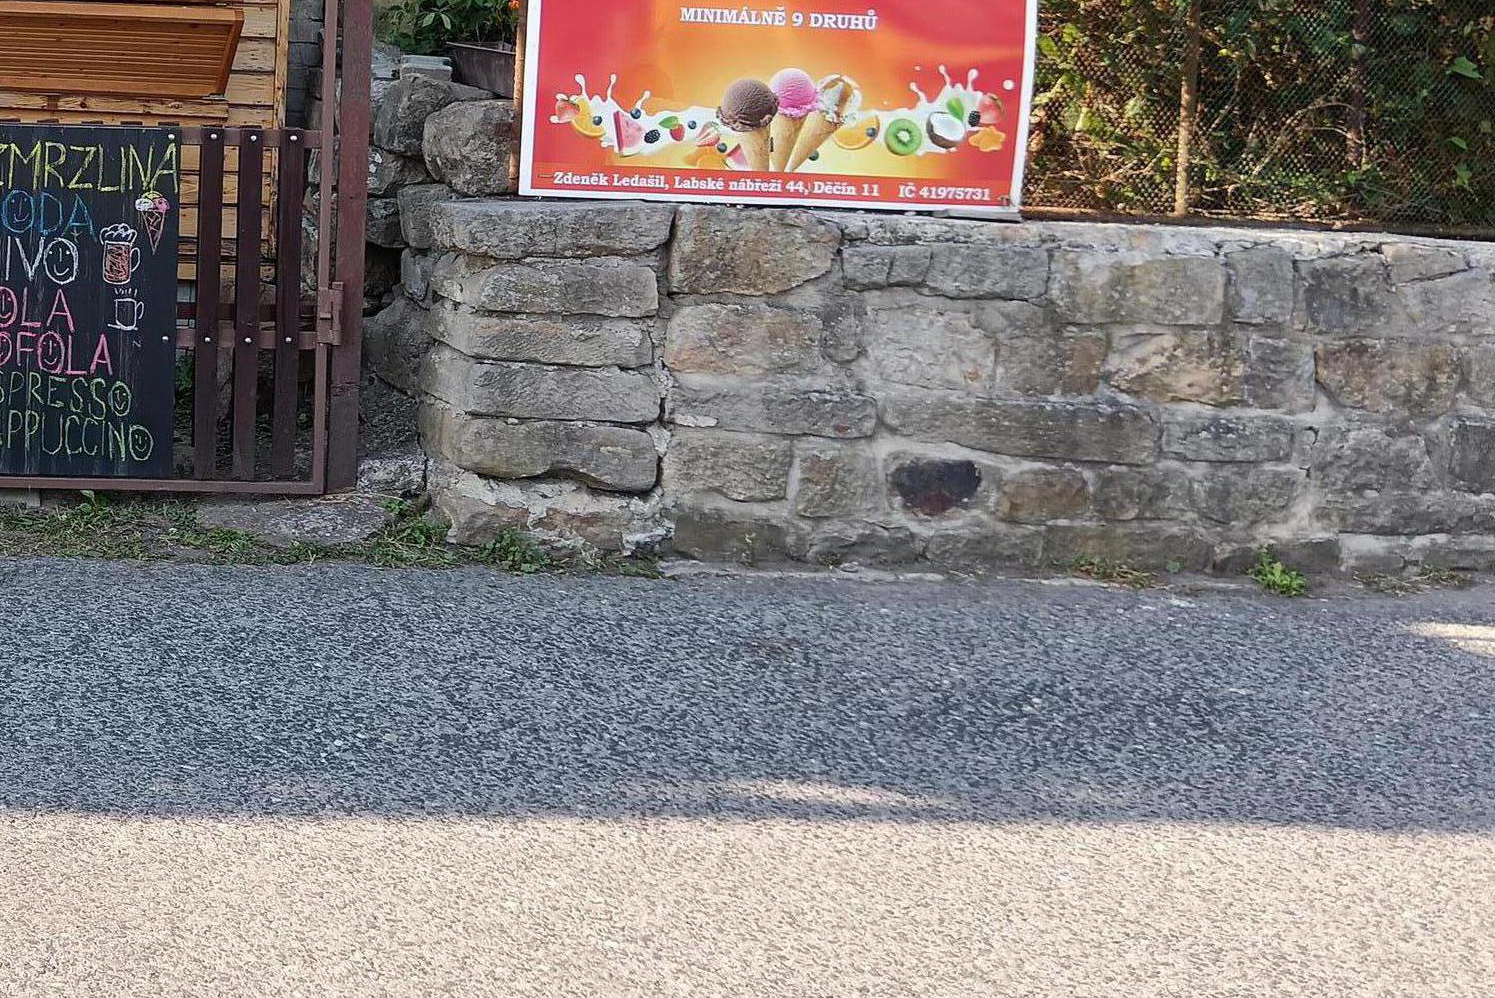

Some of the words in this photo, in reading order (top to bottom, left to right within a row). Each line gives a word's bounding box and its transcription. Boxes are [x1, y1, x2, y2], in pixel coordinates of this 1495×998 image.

[679, 5, 787, 28] MINIMÁLNĚ
[791, 11, 805, 27] 9
[808, 8, 879, 31] DRUHŮ
[552, 171, 609, 187] Zdeněk
[612, 172, 670, 191] Ledašil,
[673, 175, 725, 191] Labské
[727, 176, 783, 193] nábřeží
[784, 179, 809, 196] 44,
[812, 181, 857, 196] Děčín
[860, 183, 880, 197] 11
[897, 181, 916, 199] IČ
[918, 186, 992, 202] 41975731
